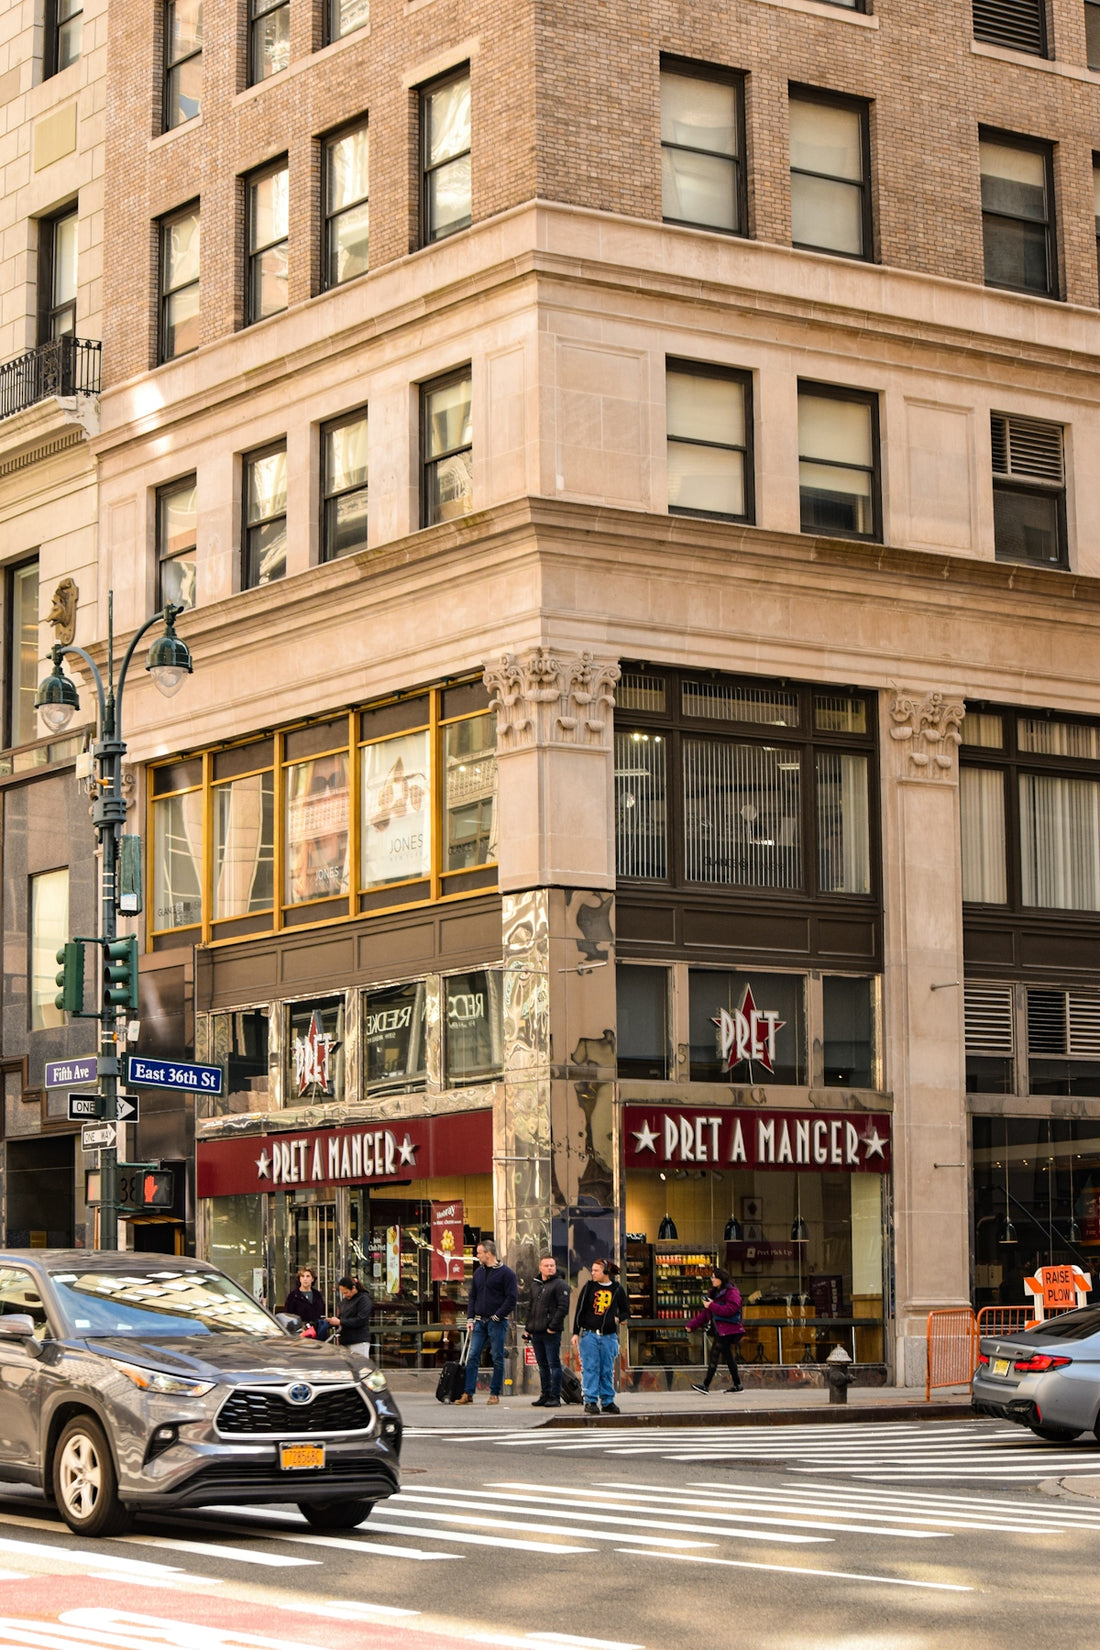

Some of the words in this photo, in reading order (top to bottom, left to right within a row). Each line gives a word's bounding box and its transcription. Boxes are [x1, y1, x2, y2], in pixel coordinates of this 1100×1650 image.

[389, 833, 424, 854] JONES
[315, 866, 340, 880] JONES
[720, 1007, 779, 1060] PRET
[295, 1032, 331, 1084] PRET
[53, 1067, 73, 1082] Fifth
[74, 1064, 89, 1079] Ave
[135, 1063, 165, 1081] East
[168, 1068, 198, 1086] 36th
[201, 1072, 216, 1088] St
[76, 1102, 96, 1112] ONE
[85, 1132, 96, 1143] ONE
[100, 1129, 112, 1140] WAY
[664, 1113, 722, 1161] PRET
[730, 1118, 747, 1162] A
[758, 1118, 860, 1165] MANGER
[272, 1138, 309, 1184] PRET
[312, 1137, 325, 1180] A
[328, 1129, 398, 1179] MANGER
[1045, 1270, 1070, 1284] RAISE
[1047, 1289, 1071, 1302] PLOW
